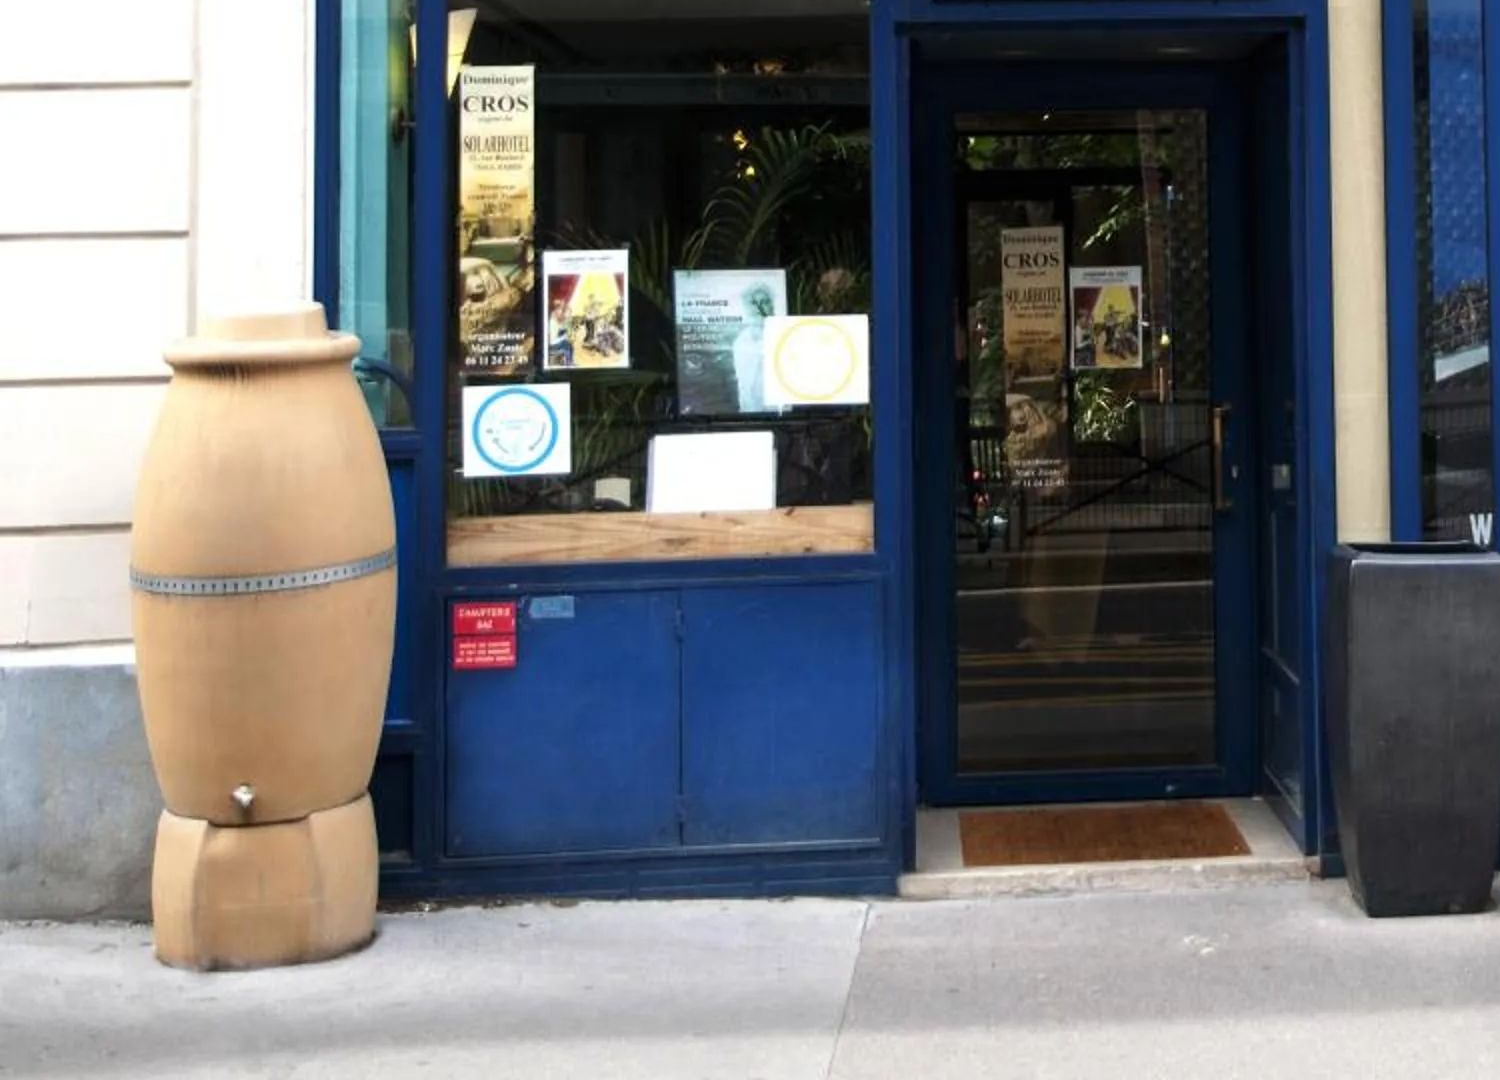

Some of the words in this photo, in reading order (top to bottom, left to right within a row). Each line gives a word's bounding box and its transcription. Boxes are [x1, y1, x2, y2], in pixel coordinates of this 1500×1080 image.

[463, 95, 529, 113] CROS
[463, 135, 530, 154] SOLARHOTEL
[1003, 251, 1060, 270] CROS
